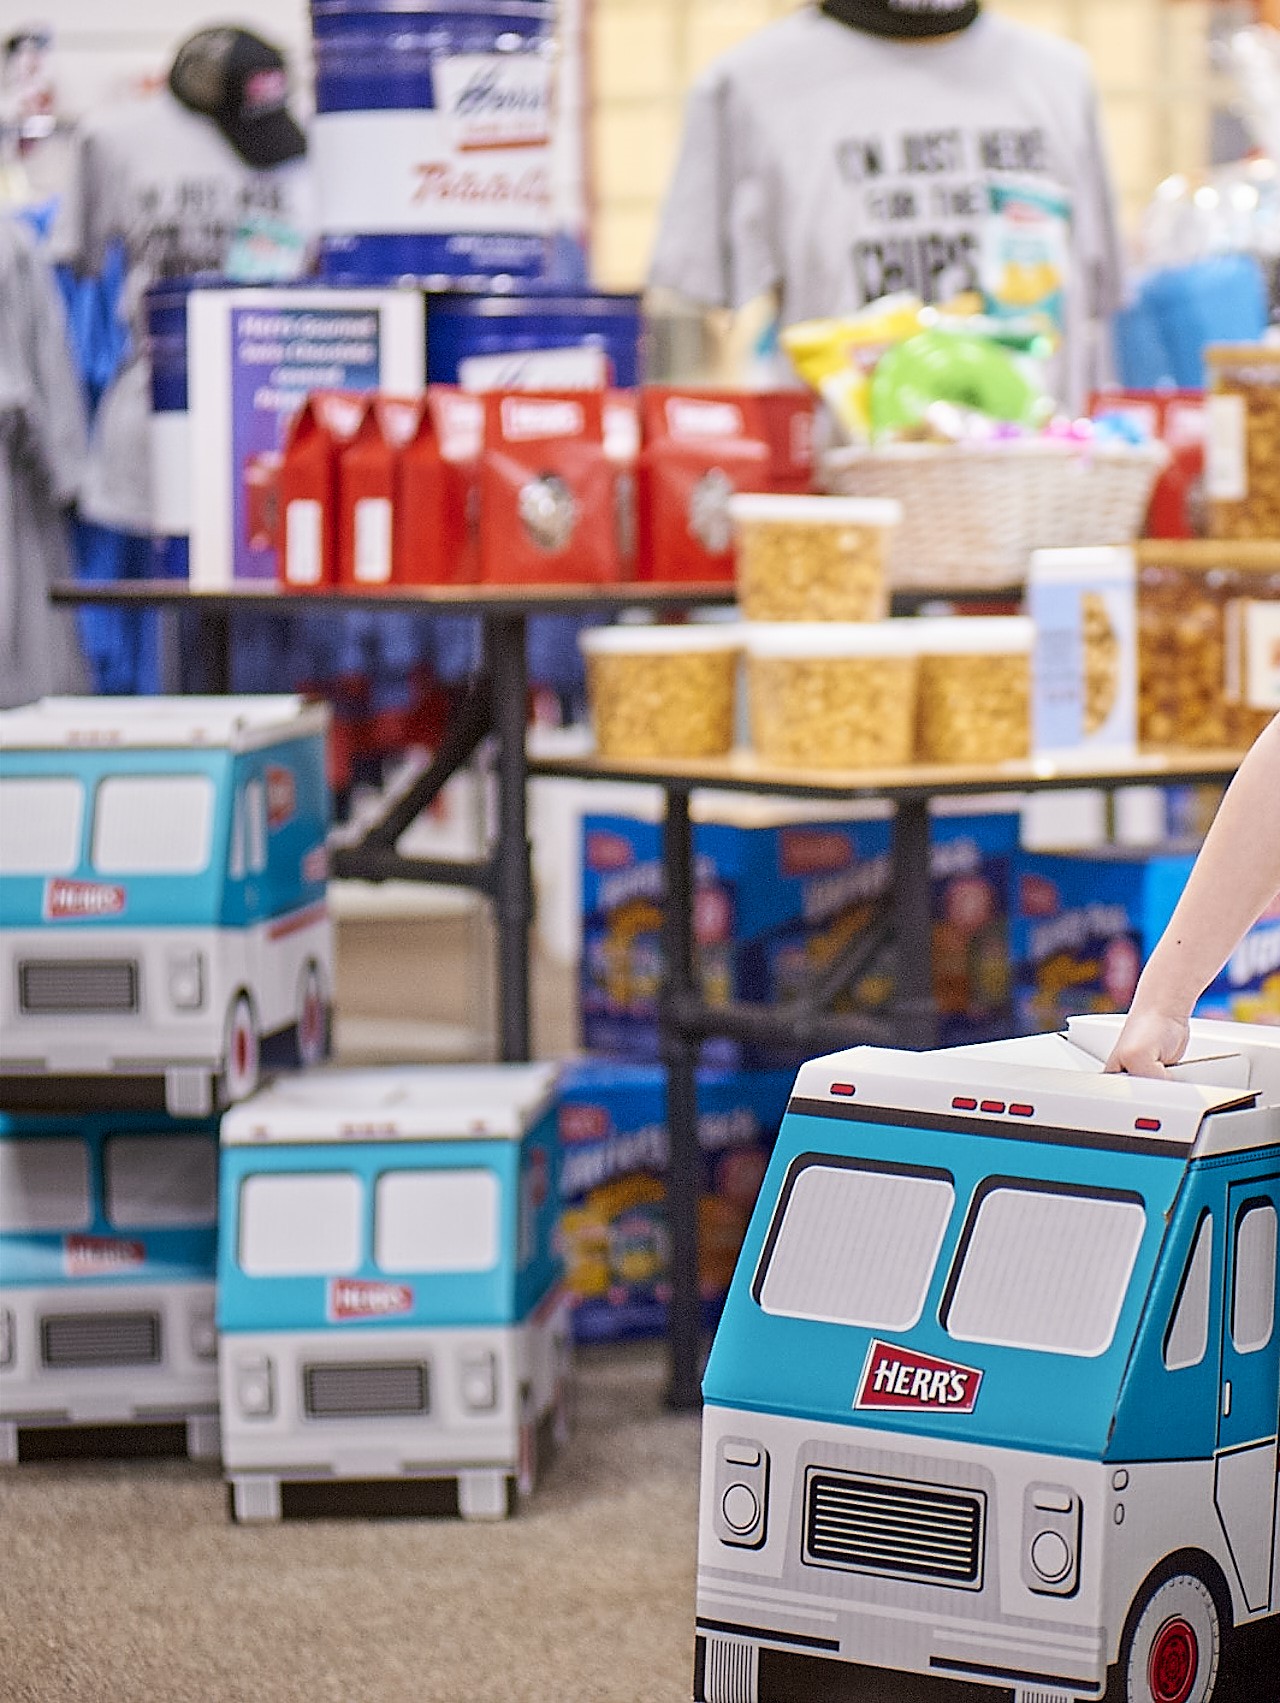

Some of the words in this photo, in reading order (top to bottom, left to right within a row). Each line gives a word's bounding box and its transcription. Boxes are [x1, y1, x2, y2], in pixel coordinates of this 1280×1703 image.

[902, 129, 960, 174] JUST
[979, 126, 1050, 171] HERE
[873, 1359, 969, 1404] HERR'S
